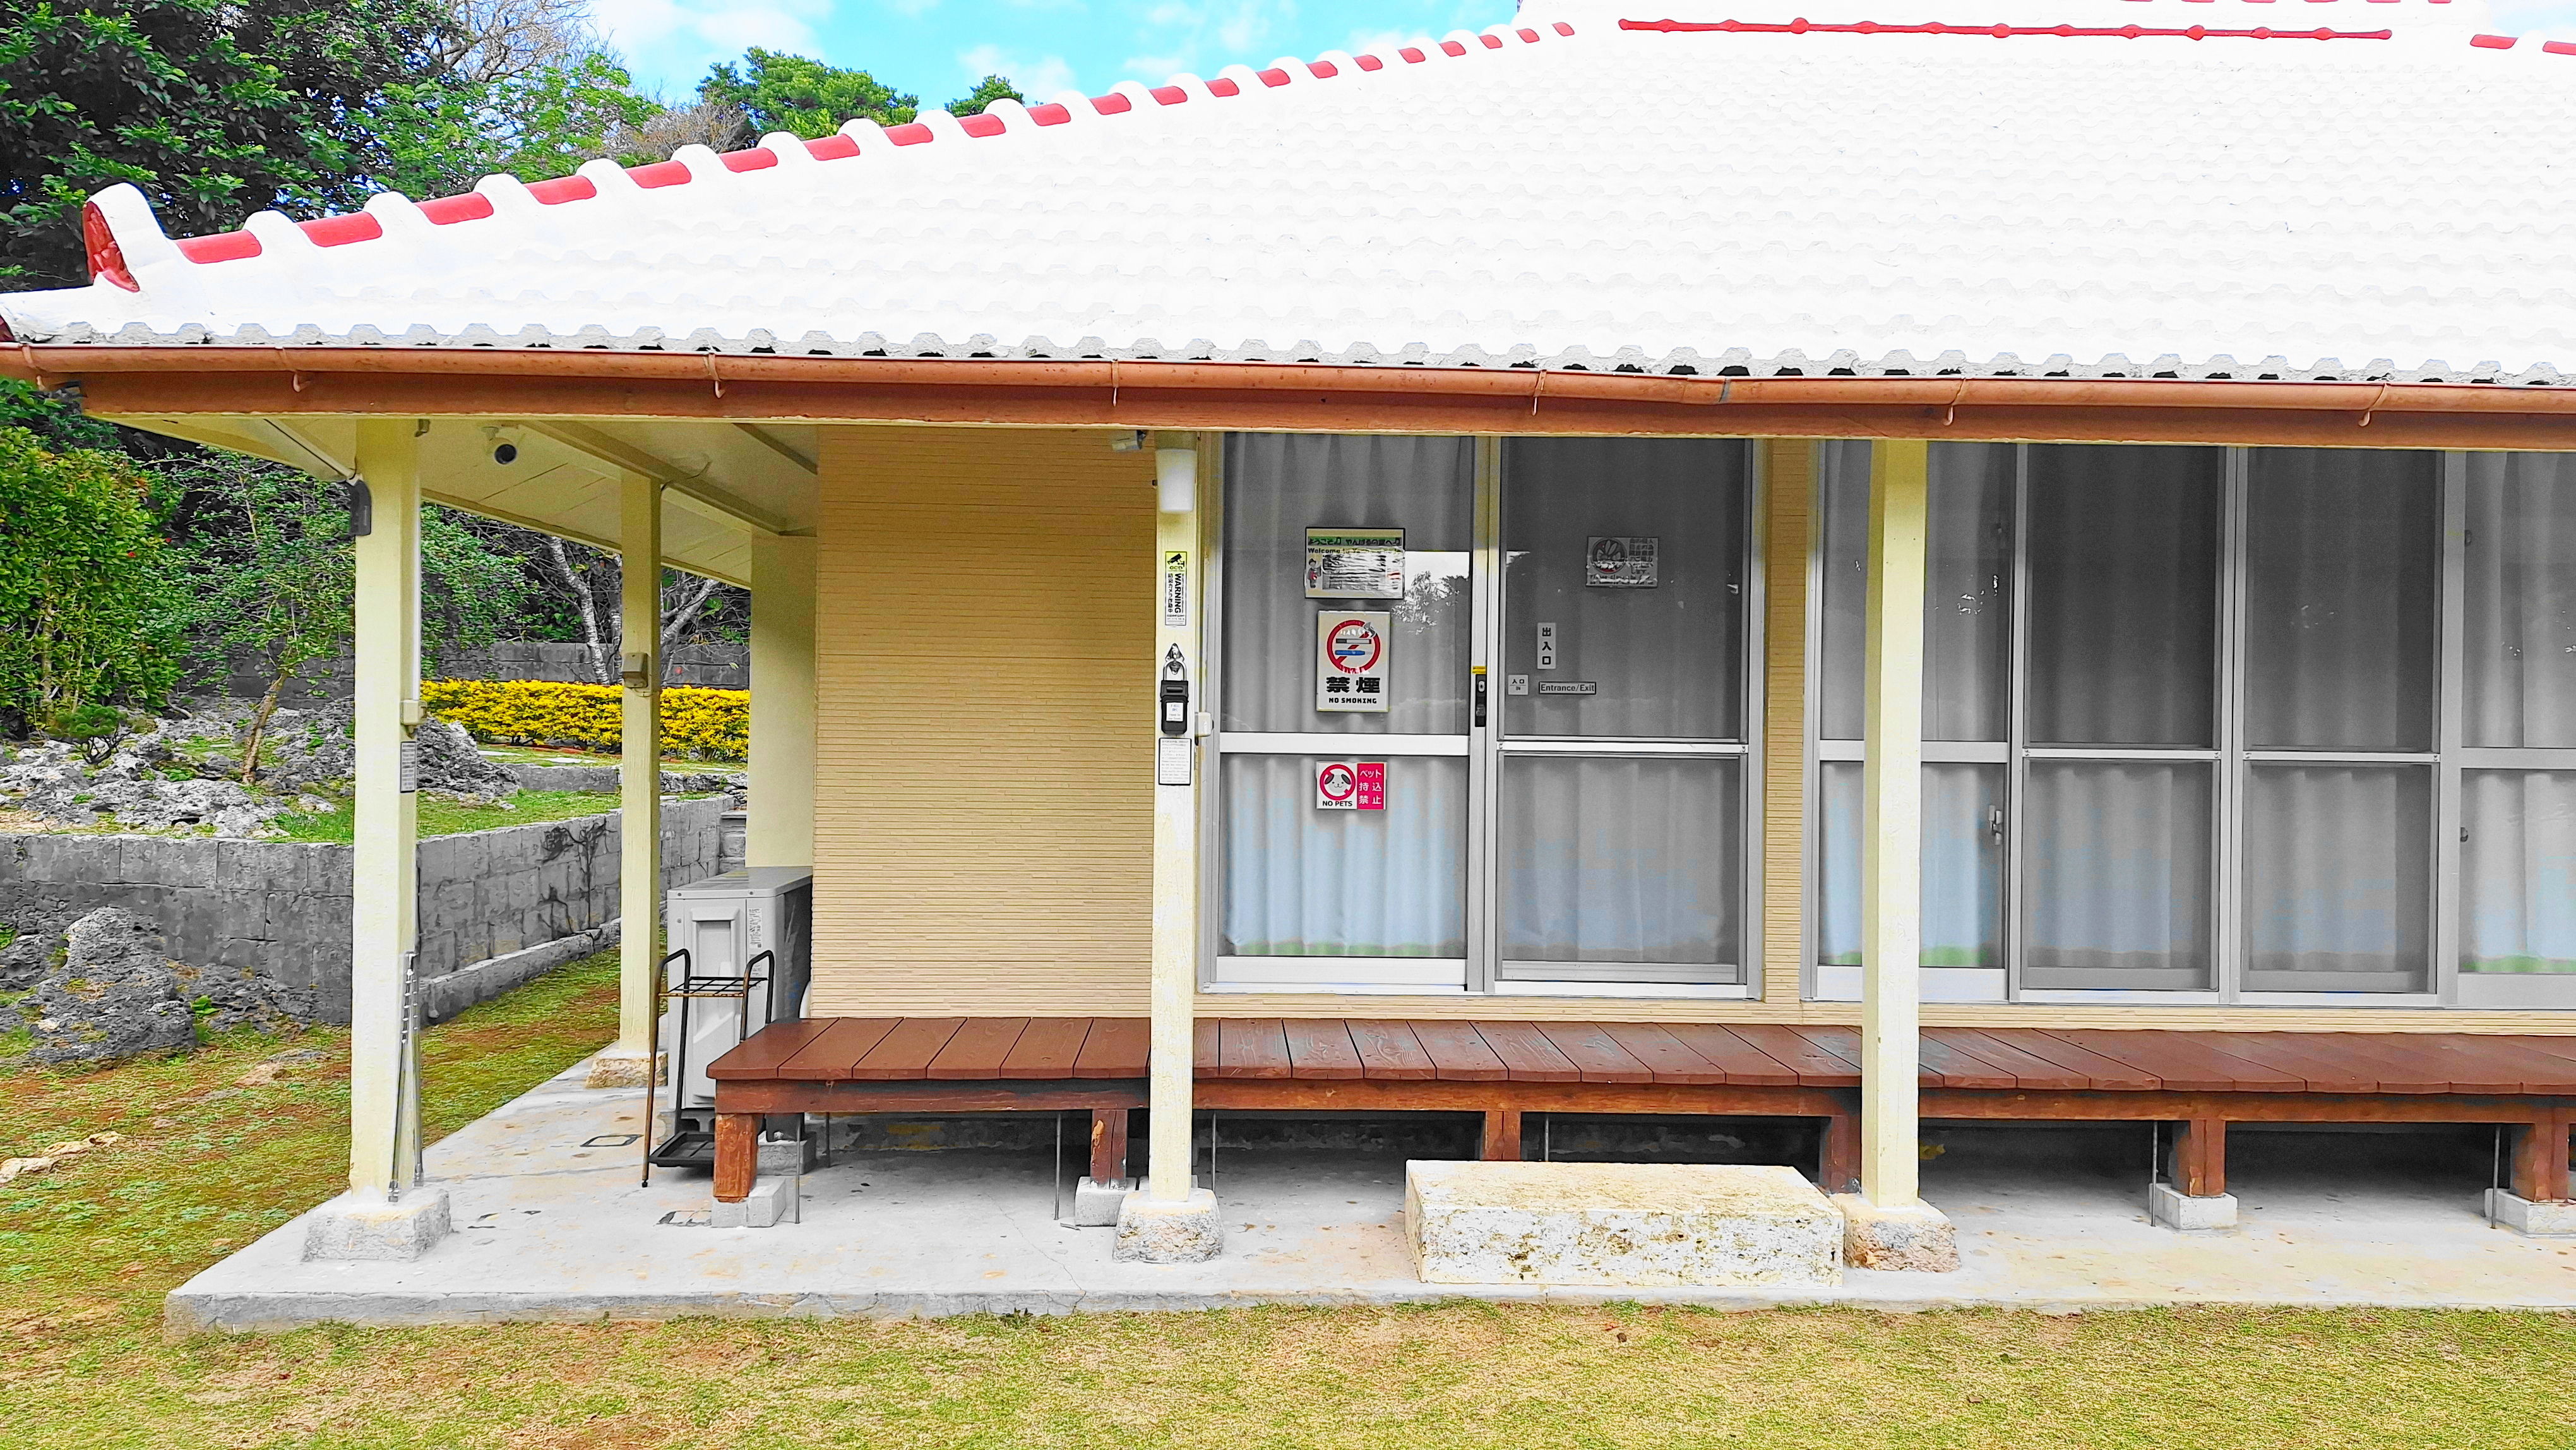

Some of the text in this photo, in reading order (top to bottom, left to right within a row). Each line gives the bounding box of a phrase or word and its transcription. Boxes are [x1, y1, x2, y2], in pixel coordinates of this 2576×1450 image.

[1542, 627, 1552, 664] 出入口
[1326, 676, 1380, 693] 禁煙
[1359, 769, 1382, 779] ペット
[1359, 782, 1382, 791] 持込
[1359, 795, 1382, 805] 禁止
